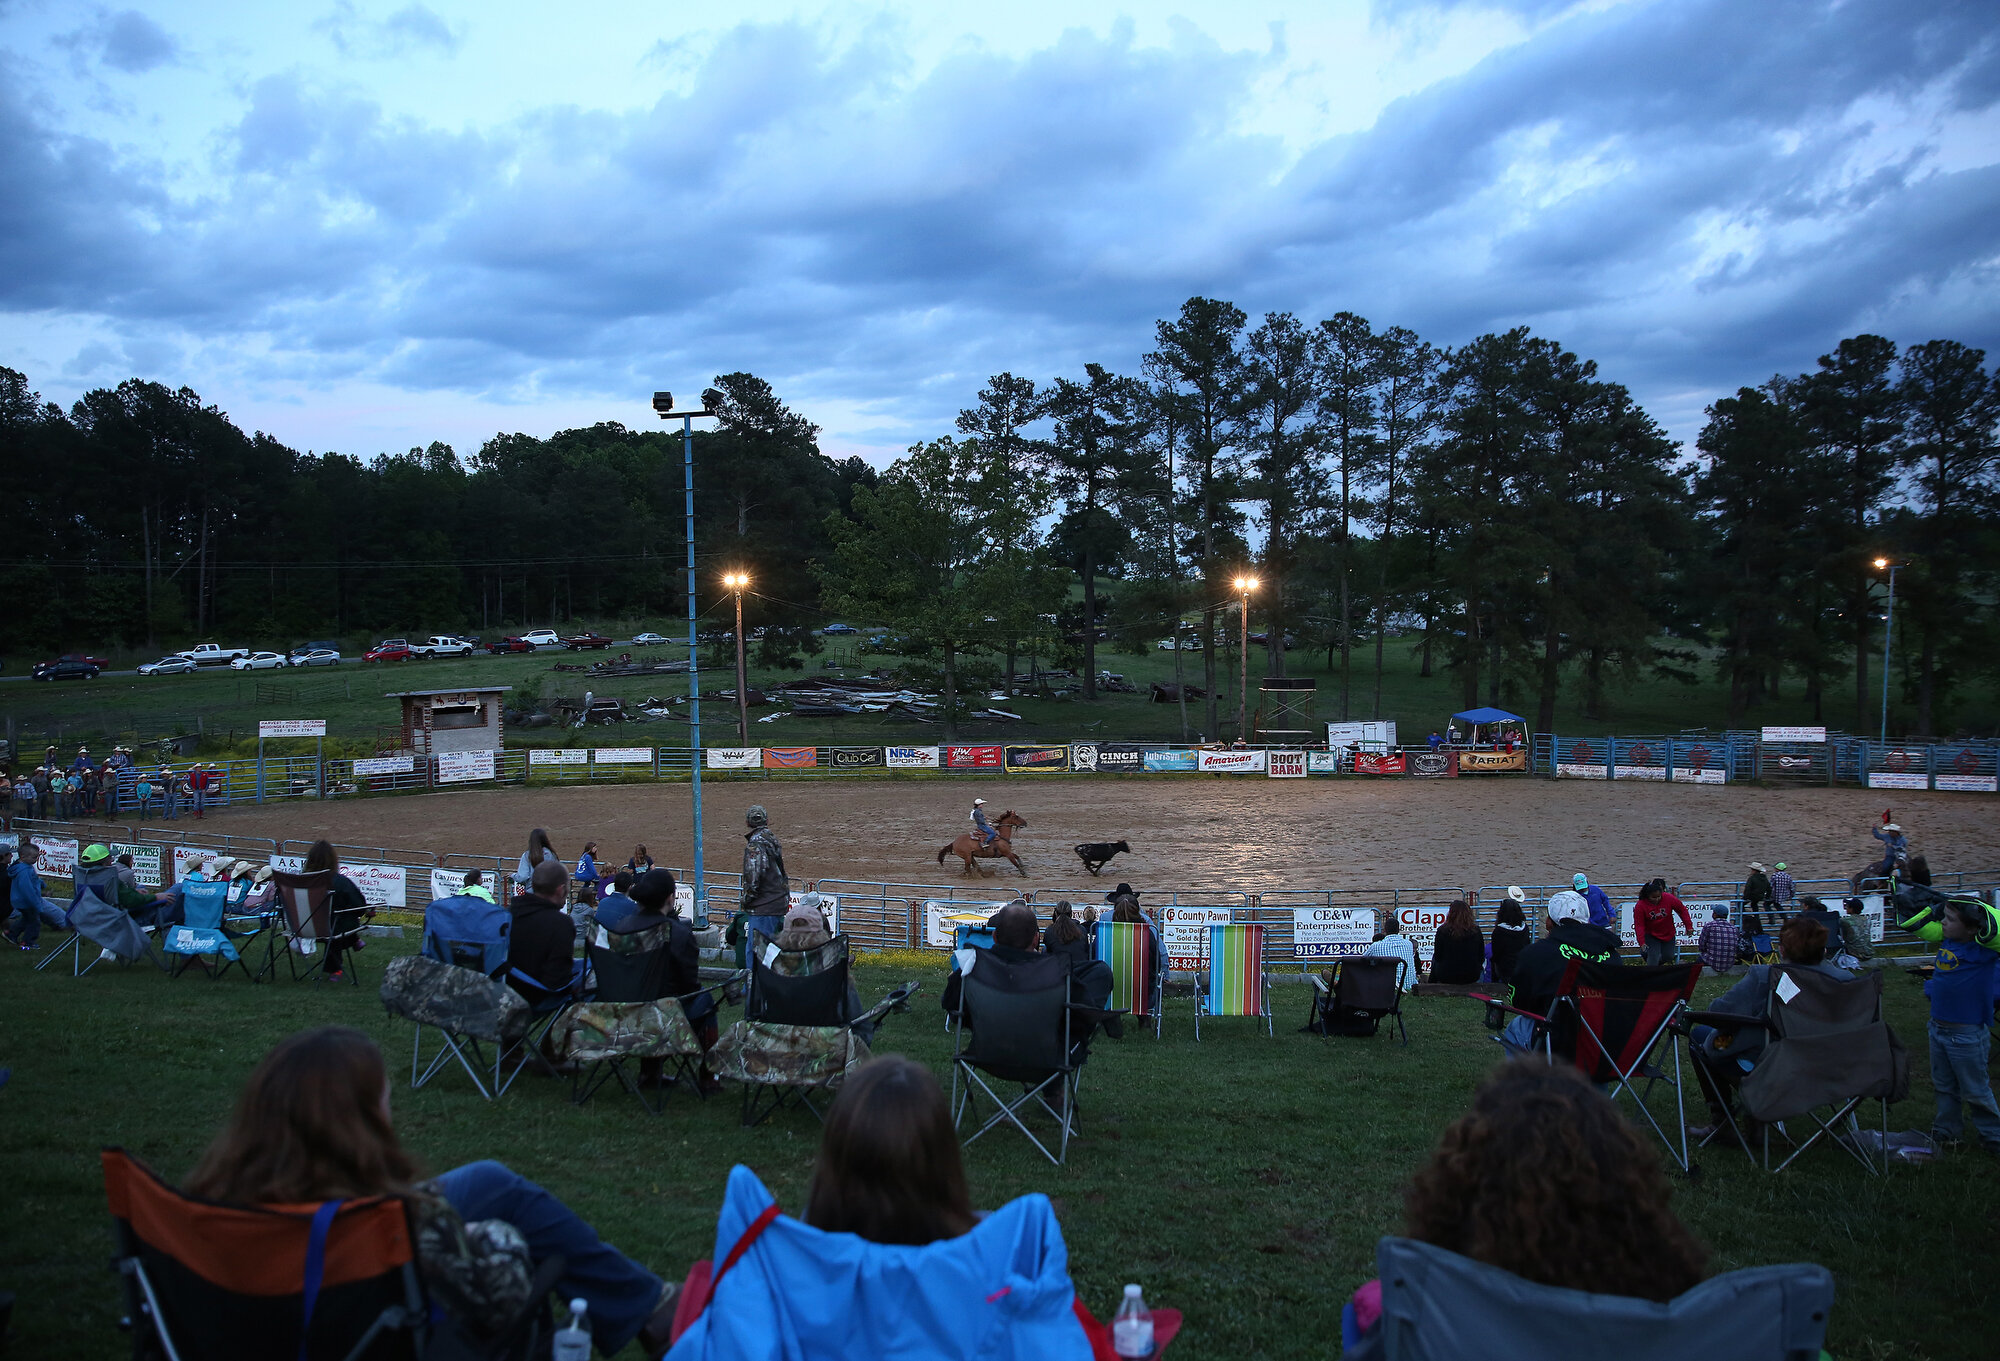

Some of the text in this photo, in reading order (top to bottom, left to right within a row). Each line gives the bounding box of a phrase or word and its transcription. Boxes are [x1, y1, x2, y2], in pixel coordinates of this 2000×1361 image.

[837, 752, 877, 763] Club Car
[889, 748, 914, 758] NRA
[1100, 752, 1138, 760] CINCH
[1145, 751, 1180, 761] LubriSyn
[1204, 754, 1252, 766] American
[1271, 755, 1302, 764] BOOT
[1271, 765, 1302, 775] BARN
[124, 846, 159, 856] ENTERPRISES
[279, 859, 286, 867] A
[289, 859, 298, 867] &
[371, 868, 400, 880] Daniels
[435, 872, 463, 882] Cavines
[143, 876, 160, 884] 3336
[1178, 910, 1206, 923] County
[1208, 910, 1229, 921] Pawn
[1313, 909, 1353, 921] CE&W
[1401, 909, 1446, 928] Clap
[1296, 921, 1372, 931] Enterprises, Inc.
[1169, 958, 1210, 969] 36-824-PA
